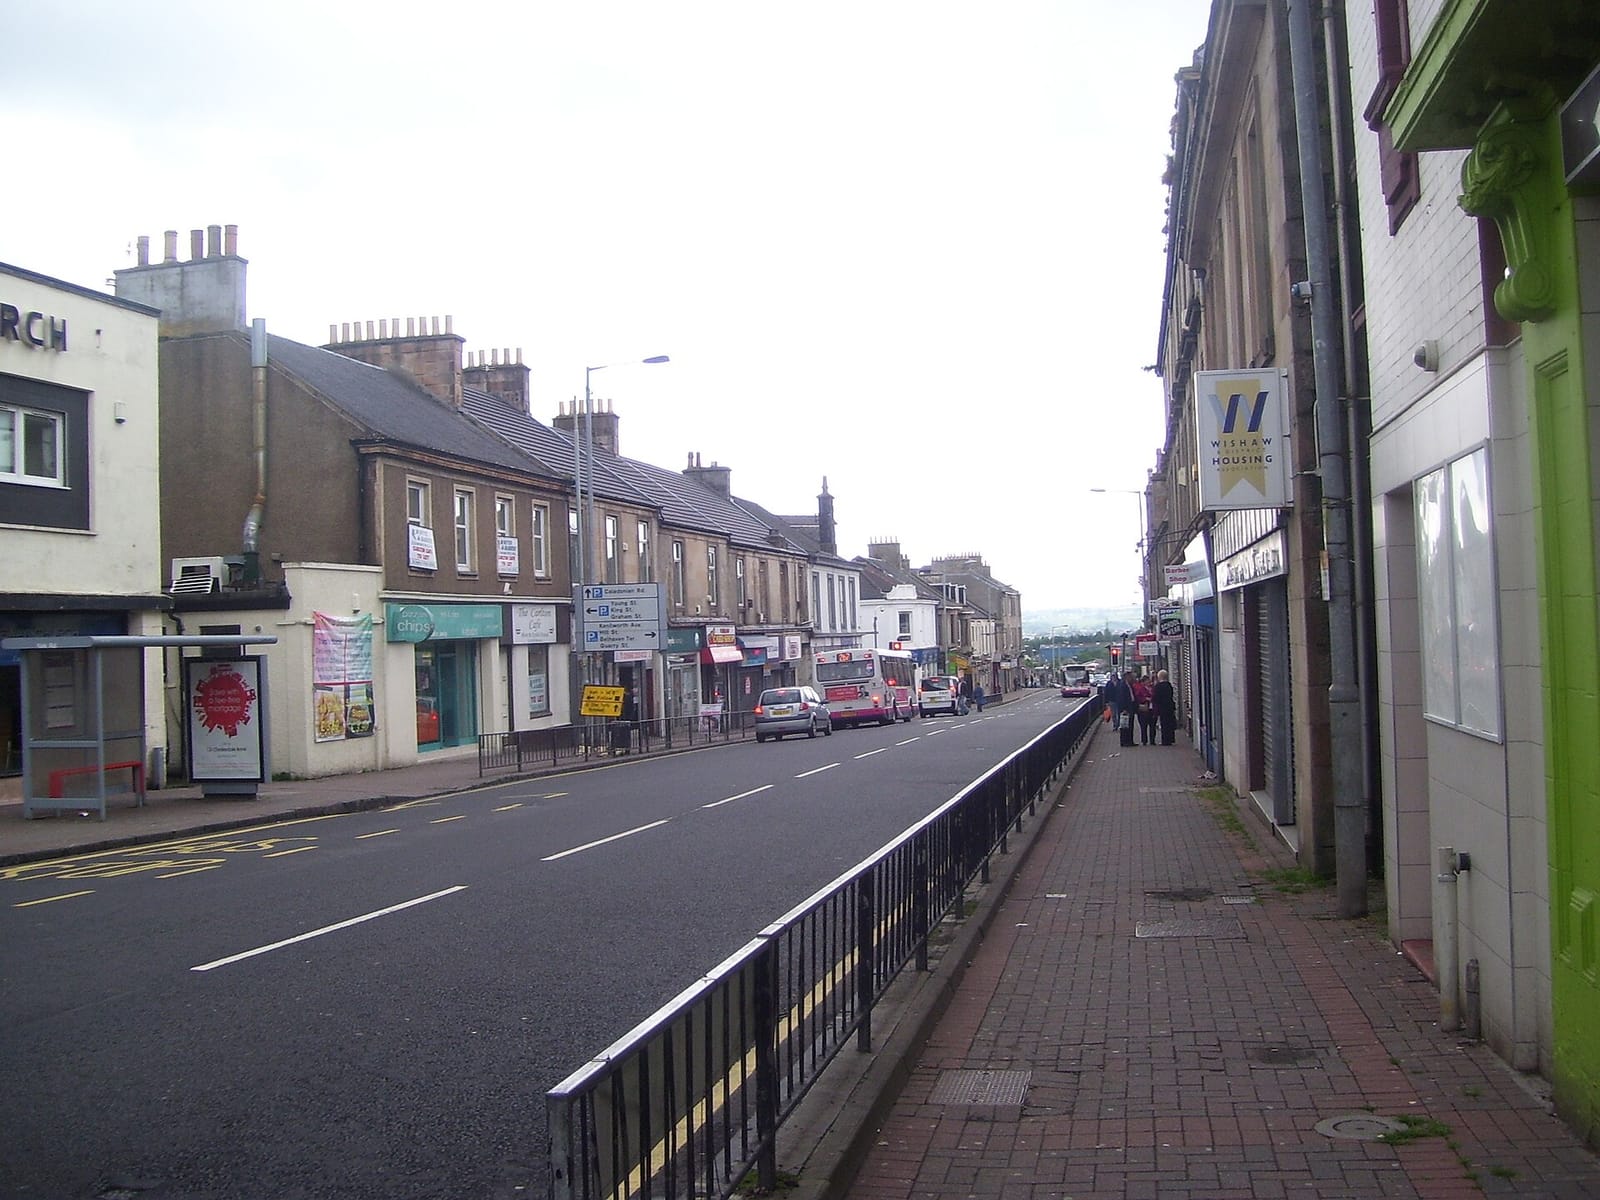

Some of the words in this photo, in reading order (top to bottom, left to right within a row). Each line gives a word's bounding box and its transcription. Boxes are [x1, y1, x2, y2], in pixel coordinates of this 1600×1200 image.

[0, 303, 67, 351] RCH
[1211, 438, 1272, 447] WISHAW
[1212, 455, 1273, 465] HOUSING
[397, 619, 431, 632] chips
[208, 705, 241, 713] mortgage
